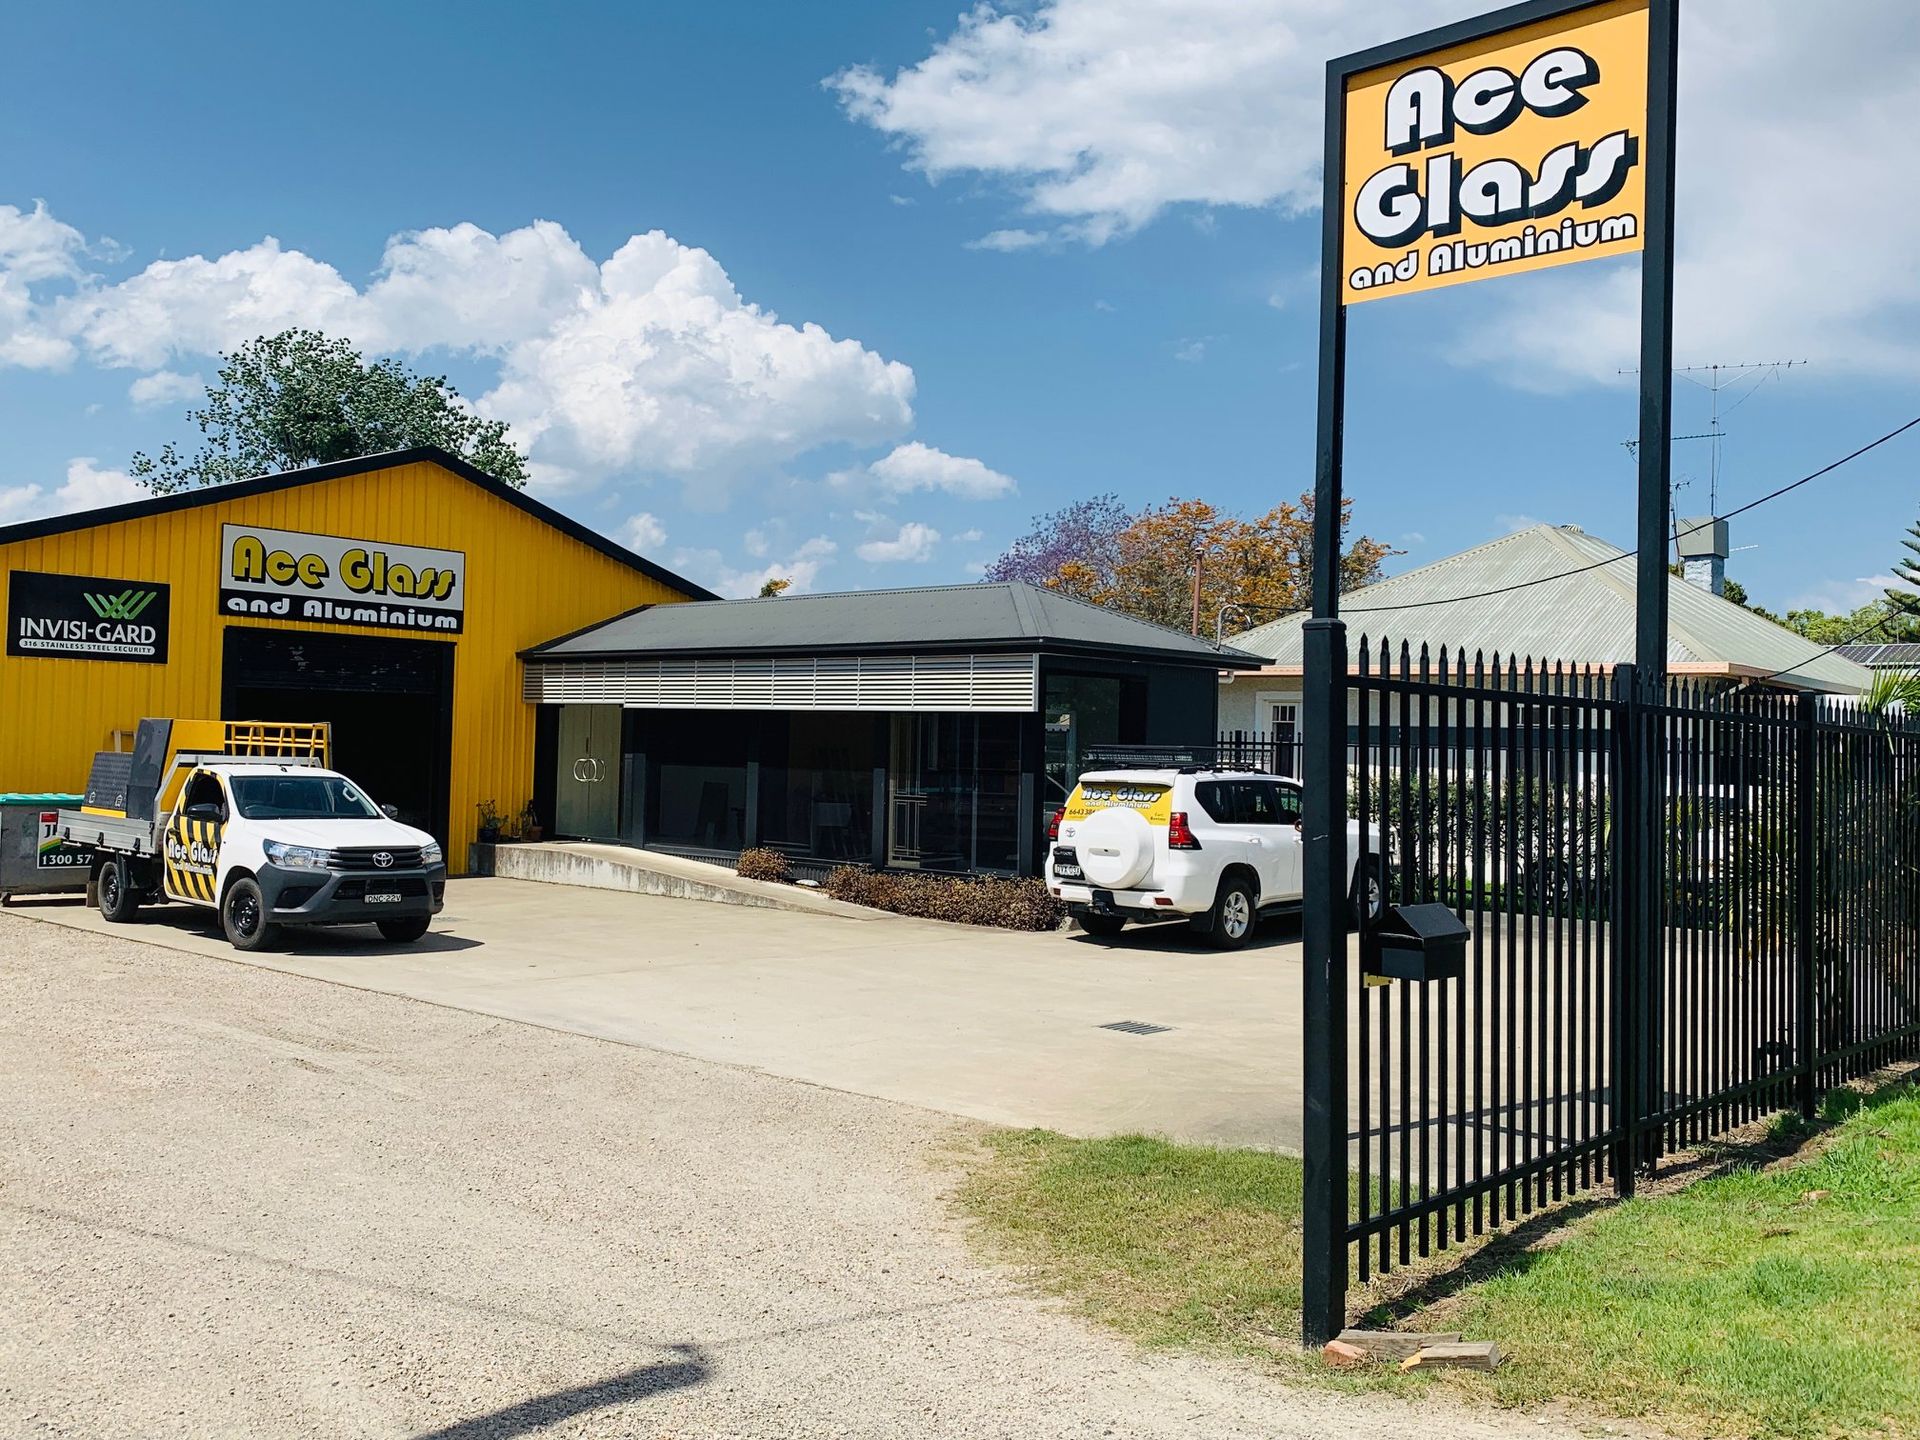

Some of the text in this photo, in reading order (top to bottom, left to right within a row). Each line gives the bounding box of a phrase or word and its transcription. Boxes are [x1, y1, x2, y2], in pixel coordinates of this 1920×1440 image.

[1384, 46, 1600, 157] Ace
[1354, 129, 1639, 249] Glass
[1349, 213, 1638, 290] and Aluminium
[231, 535, 456, 601] Ace Glass
[227, 597, 458, 629] and Aluminium
[20, 617, 157, 644] INVISI-GARD
[23, 640, 152, 654] 316 STAINLESS STEEL SECURITY
[1081, 786, 1163, 803] Ace Glass
[42, 854, 95, 865] 1300 57
[168, 838, 218, 864] Ace Glass
